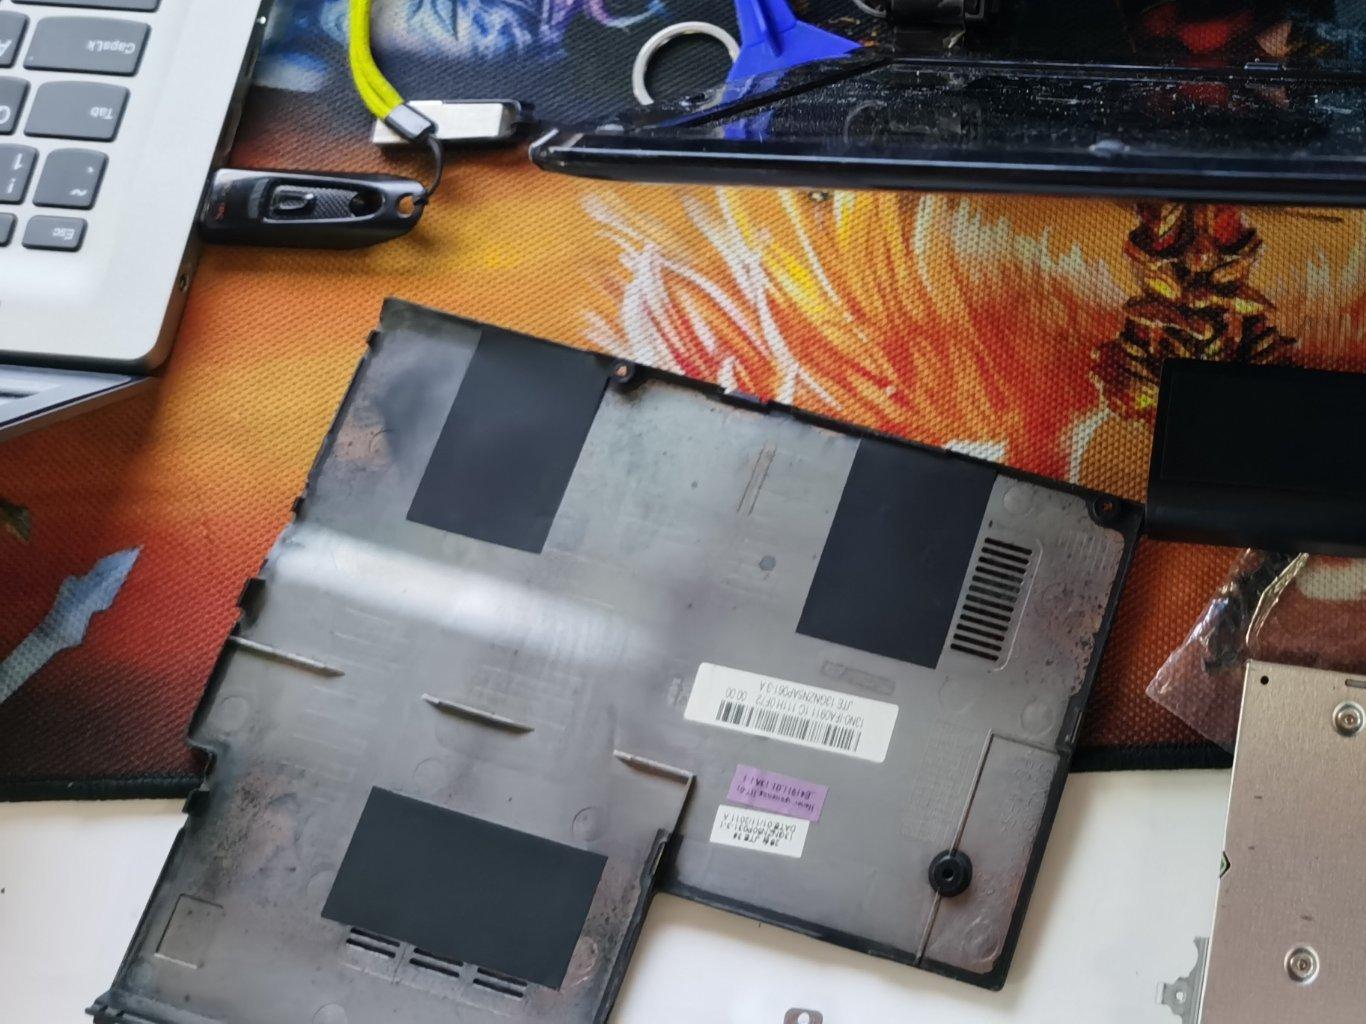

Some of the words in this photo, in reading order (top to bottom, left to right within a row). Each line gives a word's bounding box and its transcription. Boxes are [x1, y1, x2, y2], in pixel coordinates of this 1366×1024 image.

[87, 39, 136, 55] CapsLk
[90, 106, 114, 120] Tab
[52, 227, 76, 240] Esc
